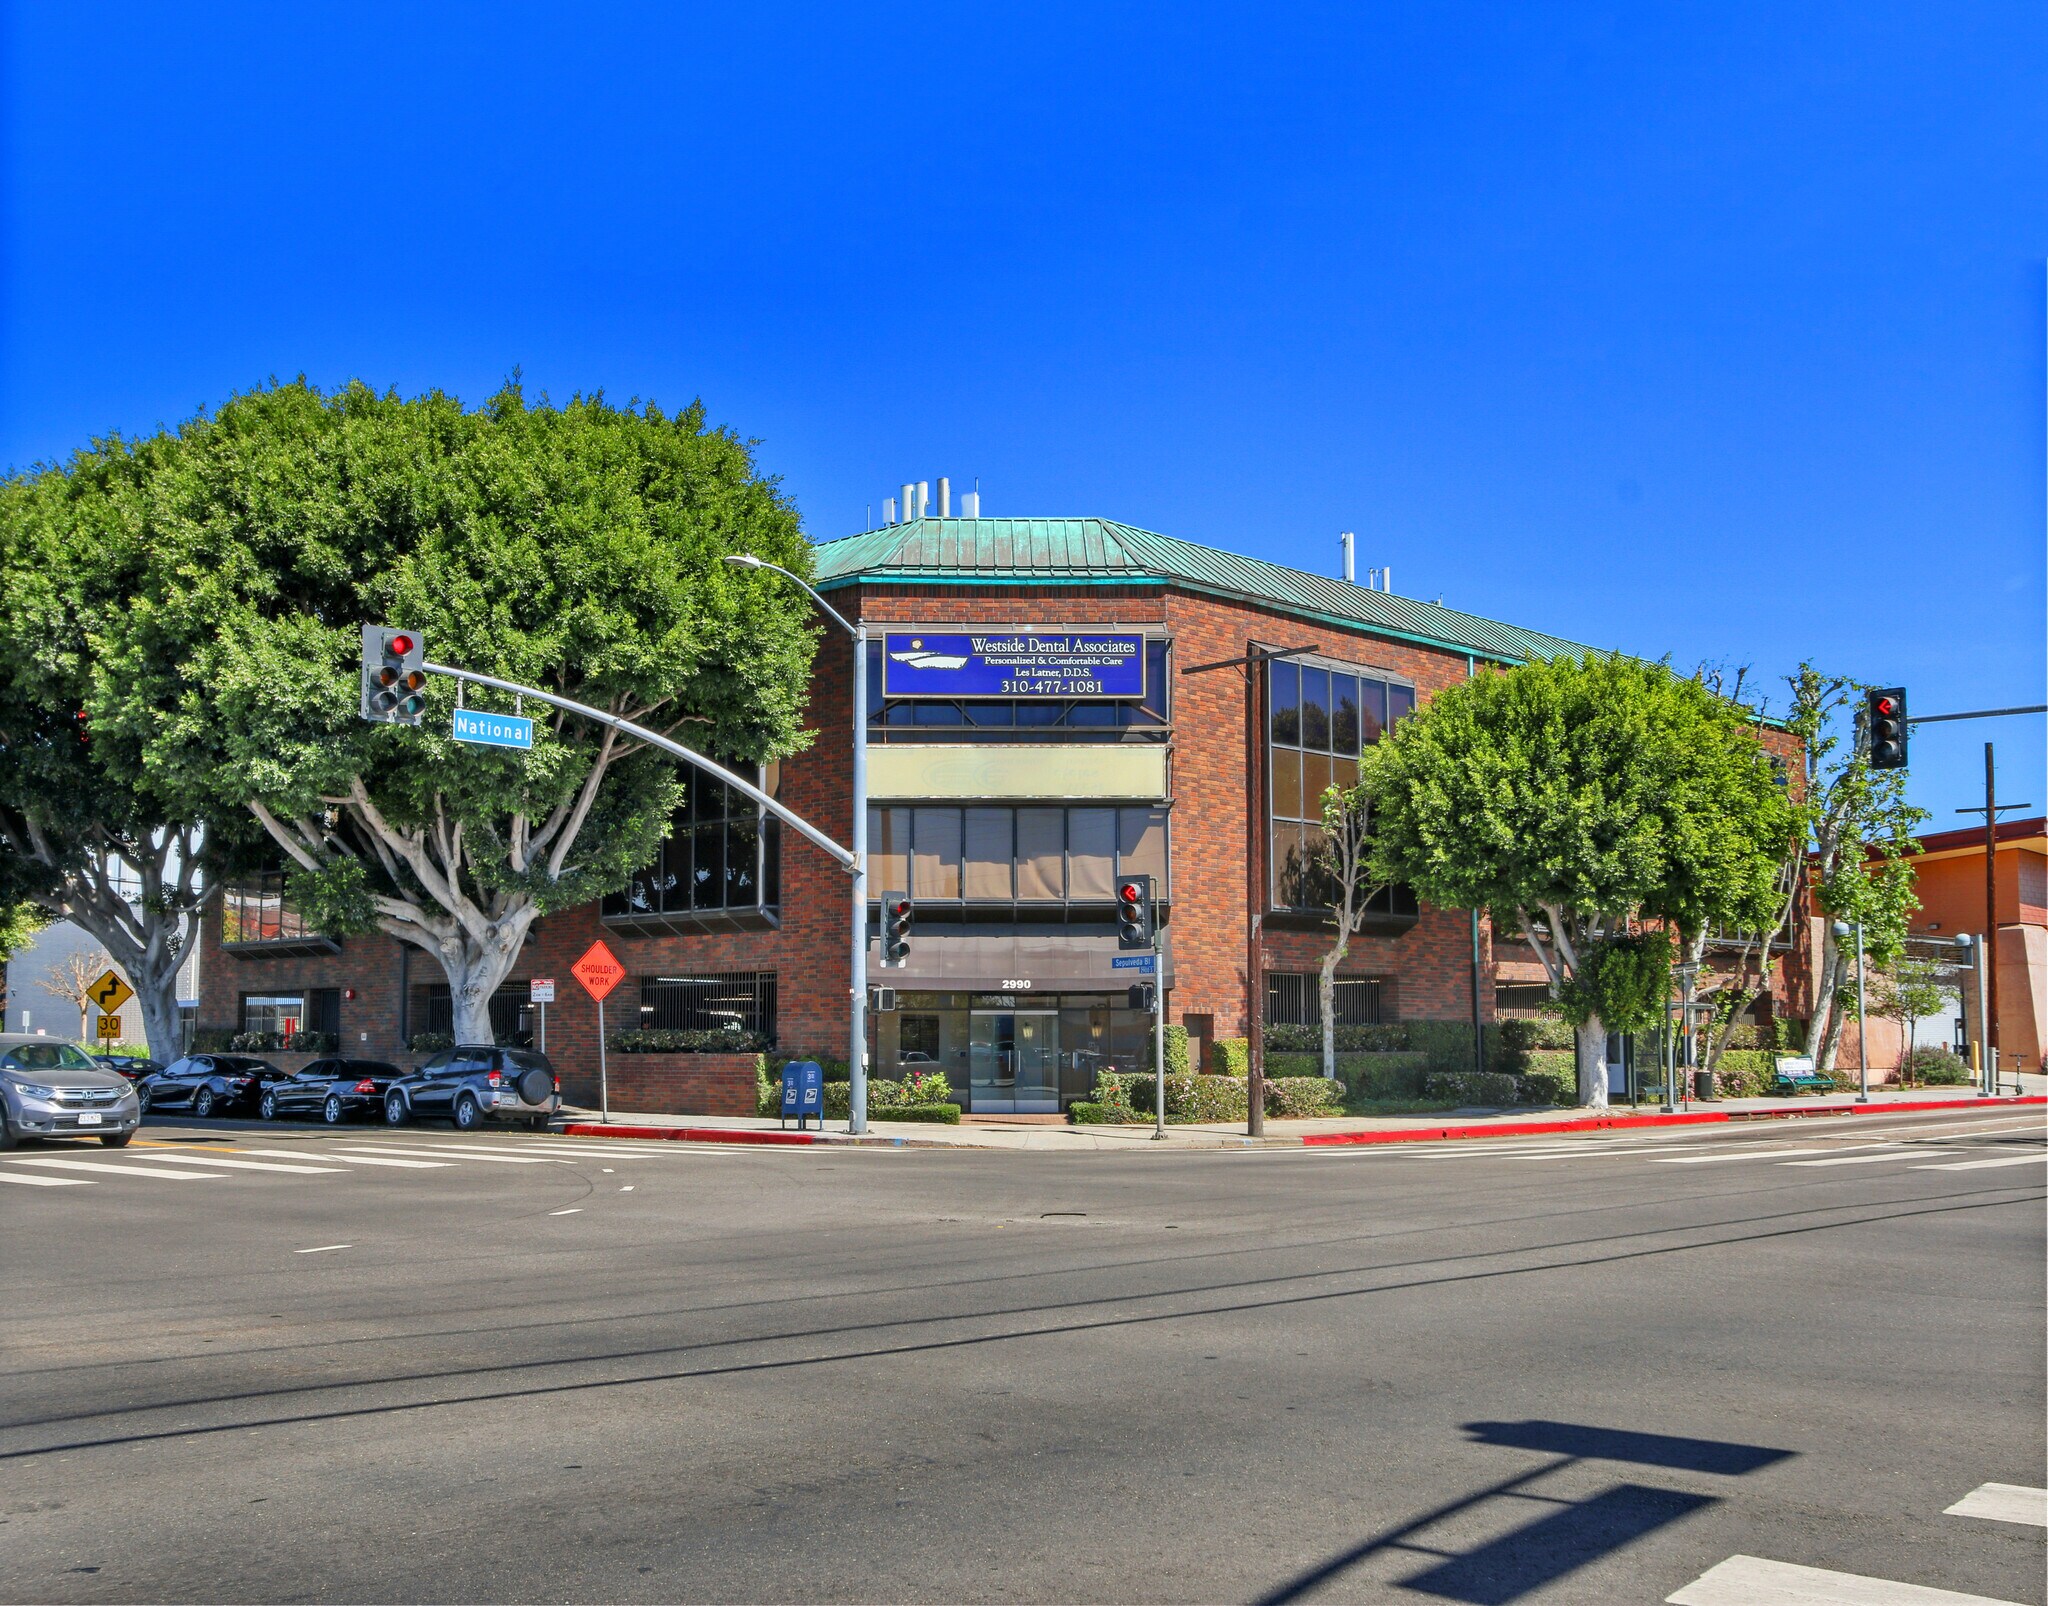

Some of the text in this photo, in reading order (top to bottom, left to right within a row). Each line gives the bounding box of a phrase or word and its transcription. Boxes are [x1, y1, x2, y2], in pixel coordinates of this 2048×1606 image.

[971, 637, 1136, 653] Westside Dental Associates
[984, 656, 1123, 665] Personalized & Comfortable Care
[1015, 667, 1092, 678] Les Latner, D.D.S.
[1001, 680, 1103, 693] 310-477-1081
[457, 717, 529, 741] National
[1115, 958, 1143, 968] Sepulveda
[581, 964, 617, 974] SHOULDER
[589, 976, 610, 986] WORK
[1001, 979, 1032, 989] 2990
[99, 1018, 119, 1030] 30
